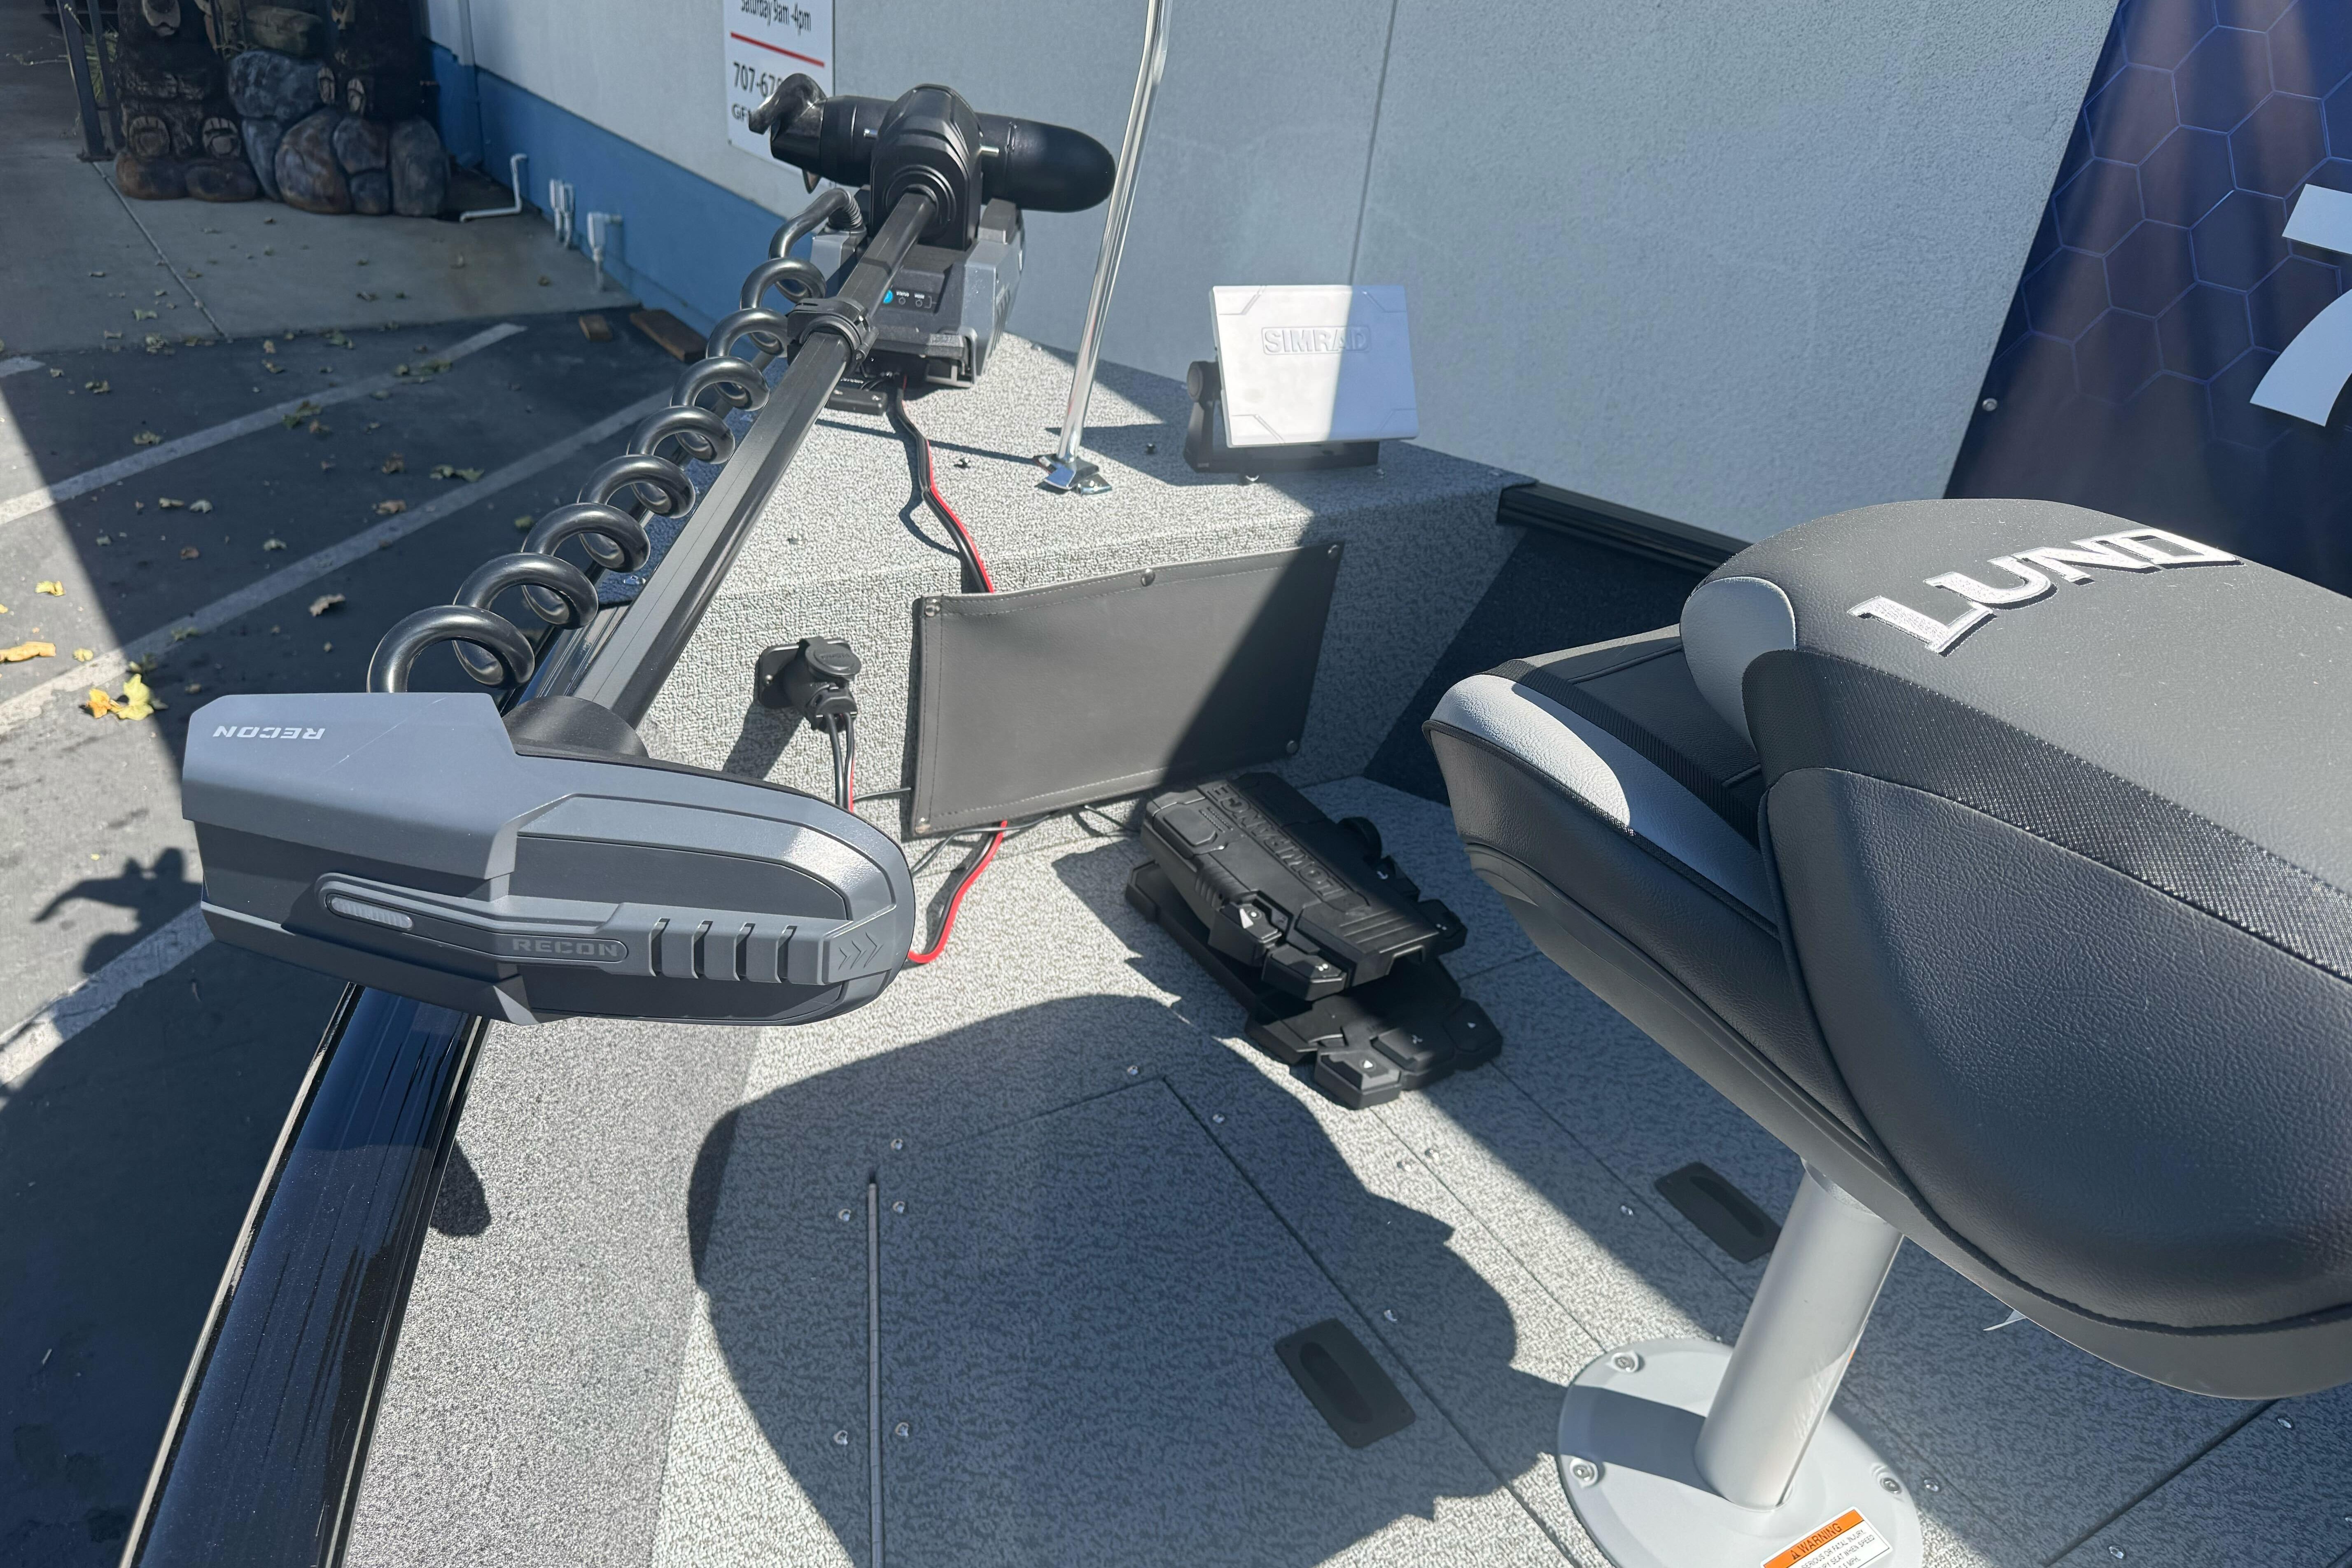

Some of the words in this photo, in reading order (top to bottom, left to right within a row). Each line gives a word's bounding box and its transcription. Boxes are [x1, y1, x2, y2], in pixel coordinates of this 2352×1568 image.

[1264, 329, 1367, 353] SIMRAD
[1848, 528, 2245, 658] LUND
[212, 726, 326, 740] RECON
[1207, 784, 1347, 898] LOWRANCE
[513, 938, 617, 957] RECON
[1797, 1523, 1842, 1553] WARNING
[1830, 1553, 1844, 1564] SEAT
[1858, 1535, 1874, 1547] SPEED
